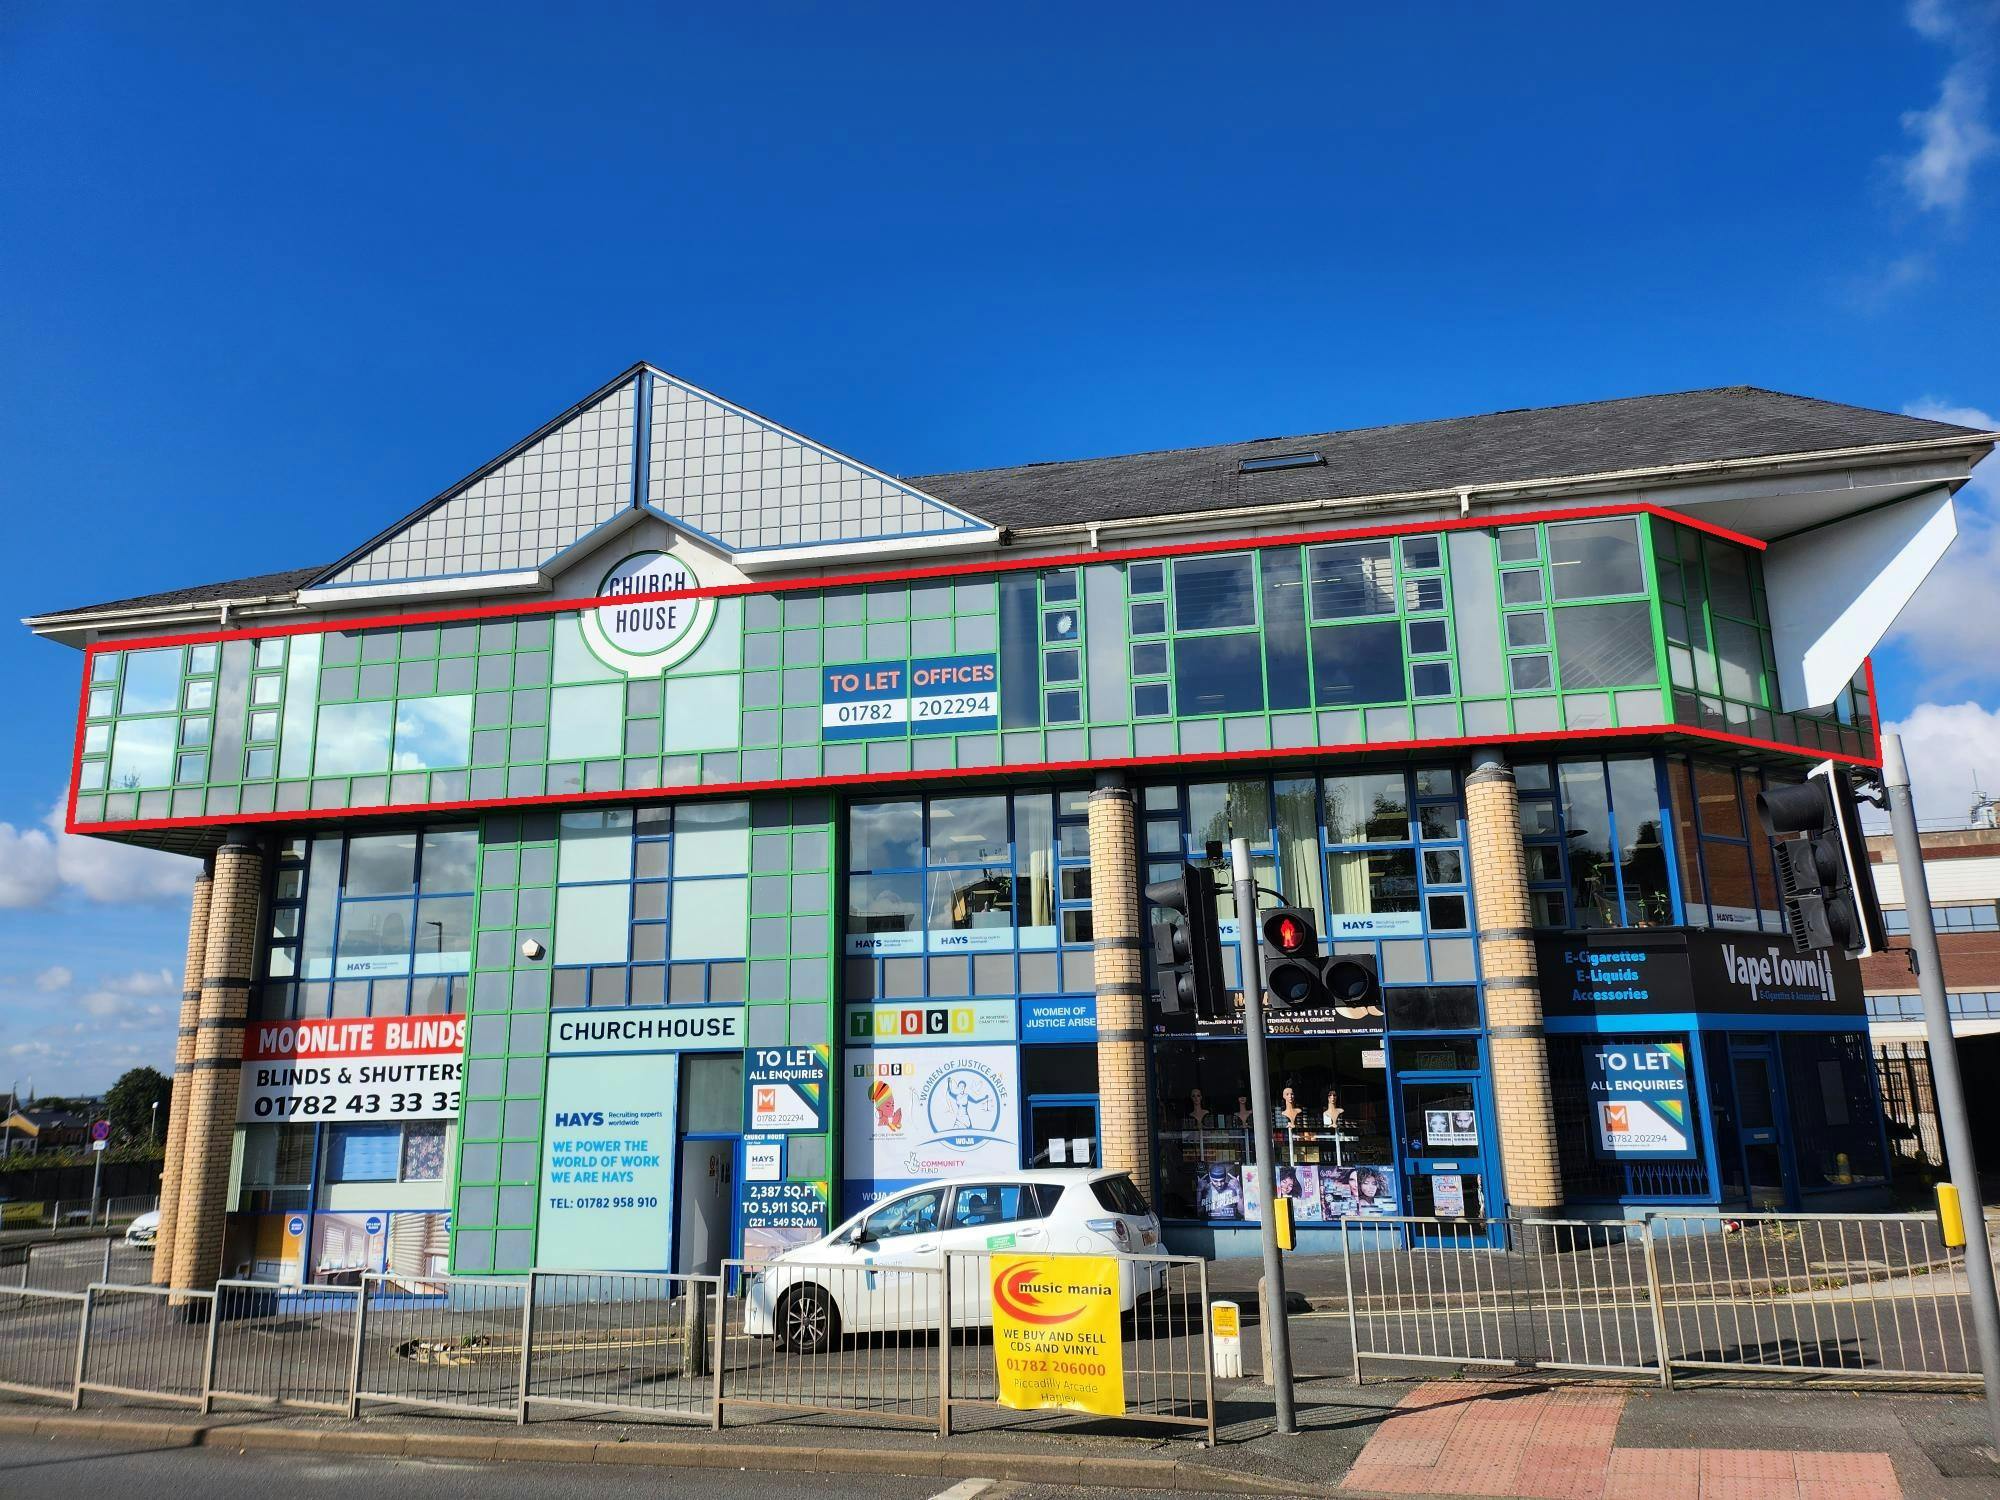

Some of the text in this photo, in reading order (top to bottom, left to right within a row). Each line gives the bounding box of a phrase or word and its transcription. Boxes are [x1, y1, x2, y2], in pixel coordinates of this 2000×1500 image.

[616, 606, 676, 633] HOUSE
[830, 664, 994, 692] TO LET OFFICES
[839, 696, 989, 722] 01782 202294
[1717, 913, 1734, 922] HAYS
[1343, 920, 1373, 930] HAYS
[856, 940, 882, 948] HAYS
[941, 936, 968, 944] HAYS
[1565, 952, 1646, 966] E-Cigarettes
[347, 962, 370, 970] HAYS
[1577, 969, 1639, 985] E-Liquids
[1572, 987, 1648, 1000] Accessories
[1033, 1006, 1086, 1016] WOMEN OF
[560, 1018, 735, 1040] CHURCH HOUSE
[1026, 1018, 1096, 1028] JUSTICE ARISE
[258, 1020, 466, 1054] MOONLITE BLINDS
[756, 1050, 816, 1067] TO LET
[1595, 1052, 1671, 1070] TO LET
[256, 1064, 462, 1086] BLINDS & SHUTTERS
[749, 1070, 823, 1080] ALL ENQUIRIES
[920, 1060, 1008, 1101] WOMEN OF JUSTICE ARISE
[1591, 1080, 1684, 1092] ALL ENQUIRIES
[254, 1092, 460, 1116] 01782 43 33 33
[555, 1112, 604, 1126] HAYS
[756, 1114, 804, 1122] 01782 202294
[955, 1137, 974, 1146] WOJA
[1608, 1135, 1667, 1143] 01782 202294
[553, 1140, 648, 1152] WE POWER THE
[552, 1156, 660, 1167] WORLD OF WORK
[922, 1160, 965, 1168] COMMUNITY
[552, 1172, 634, 1182] WE ARE HAYS
[750, 1186, 818, 1198] 2,387 SQ.FT
[550, 1197, 658, 1208] TEL: 01782 958 910
[742, 1202, 826, 1215] TO 5,911 SQ.FT
[749, 1218, 766, 1228] (221
[774, 1218, 790, 1227] 549
[791, 1218, 818, 1228] SQ.M)
[1020, 1282, 1112, 1296] music mania
[1004, 1329, 1106, 1344] WE BUY AND SELL
[1010, 1342, 1099, 1356] CDS AND VINYL
[1006, 1358, 1106, 1376] 01782 206000
[1014, 1378, 1099, 1394] Piccadilly Arcade
[1041, 1392, 1076, 1404] Hanley
